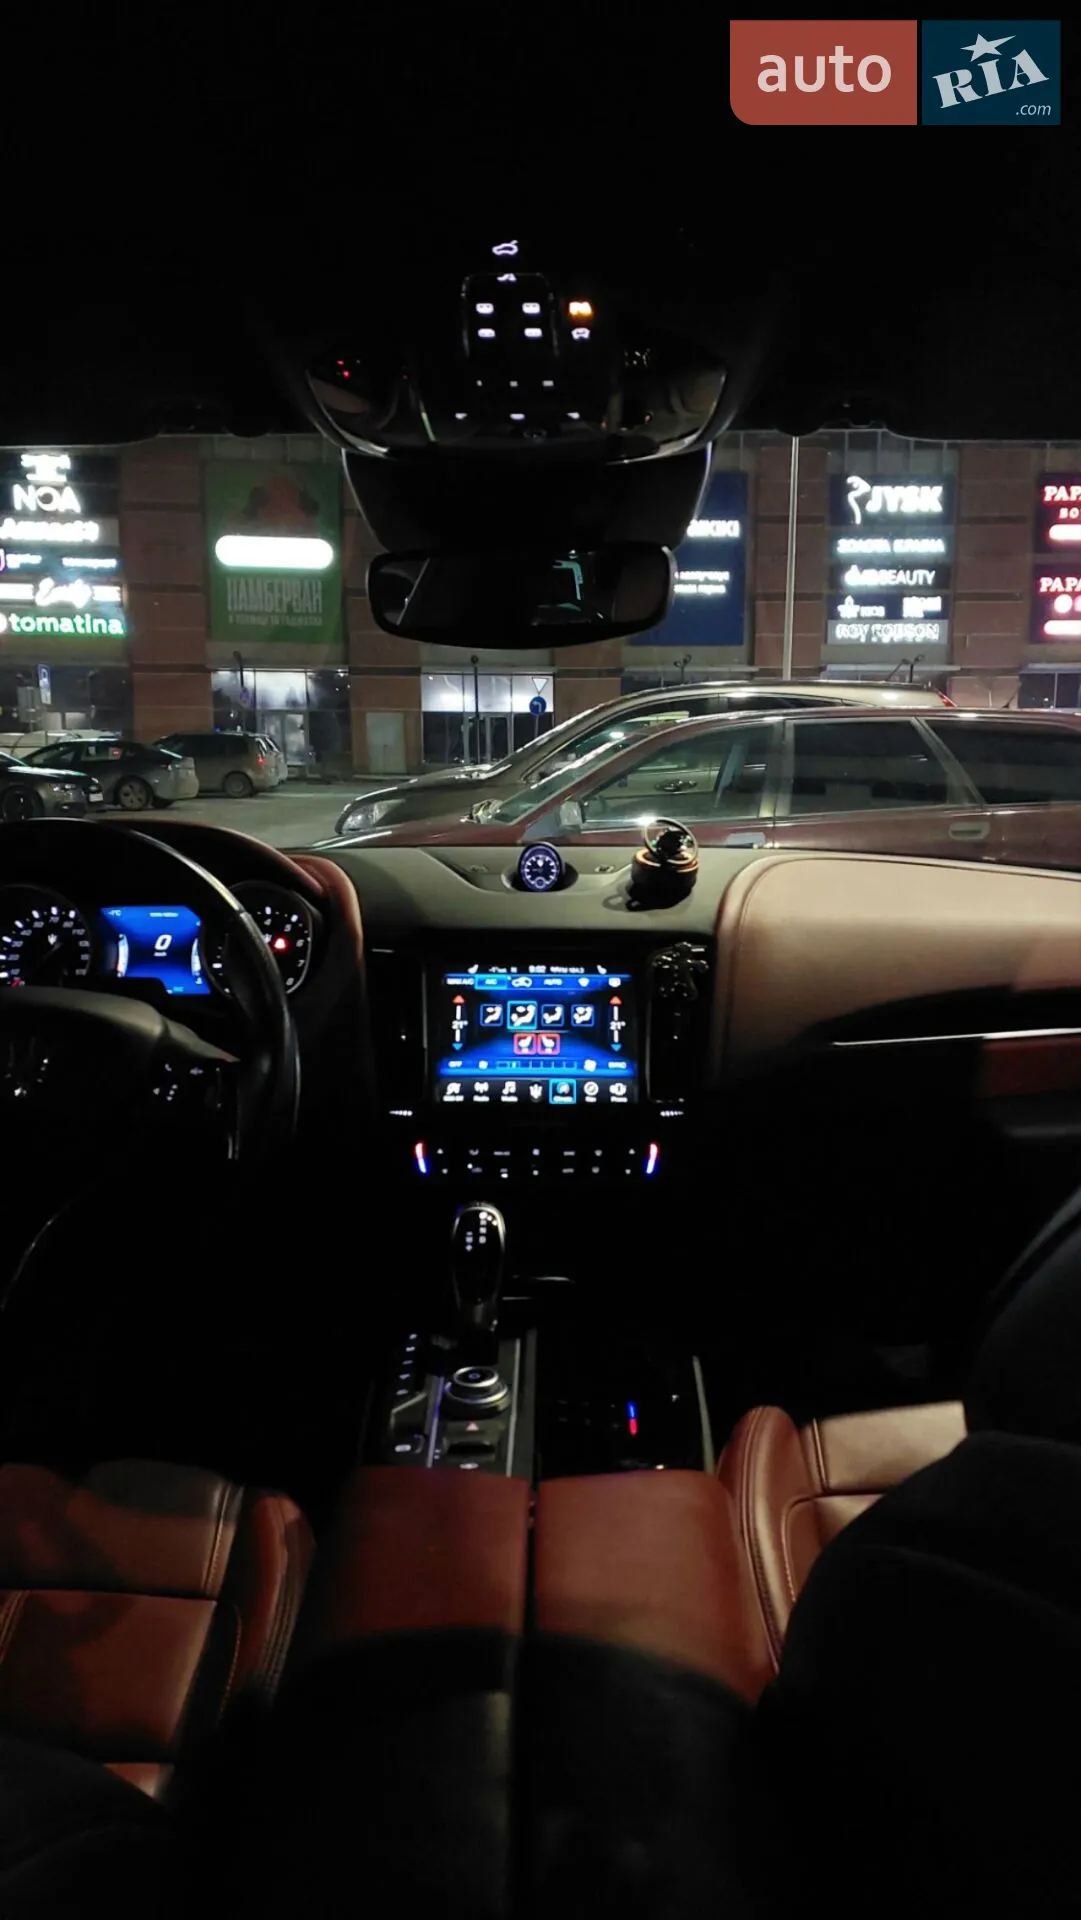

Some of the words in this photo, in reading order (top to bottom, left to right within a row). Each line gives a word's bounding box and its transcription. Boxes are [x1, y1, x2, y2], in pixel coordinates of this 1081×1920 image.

[865, 486, 943, 512] JYSK
[1044, 485, 1081, 501] PAP
[8, 613, 125, 635] tomatina
[154, 935, 172, 950] 0
